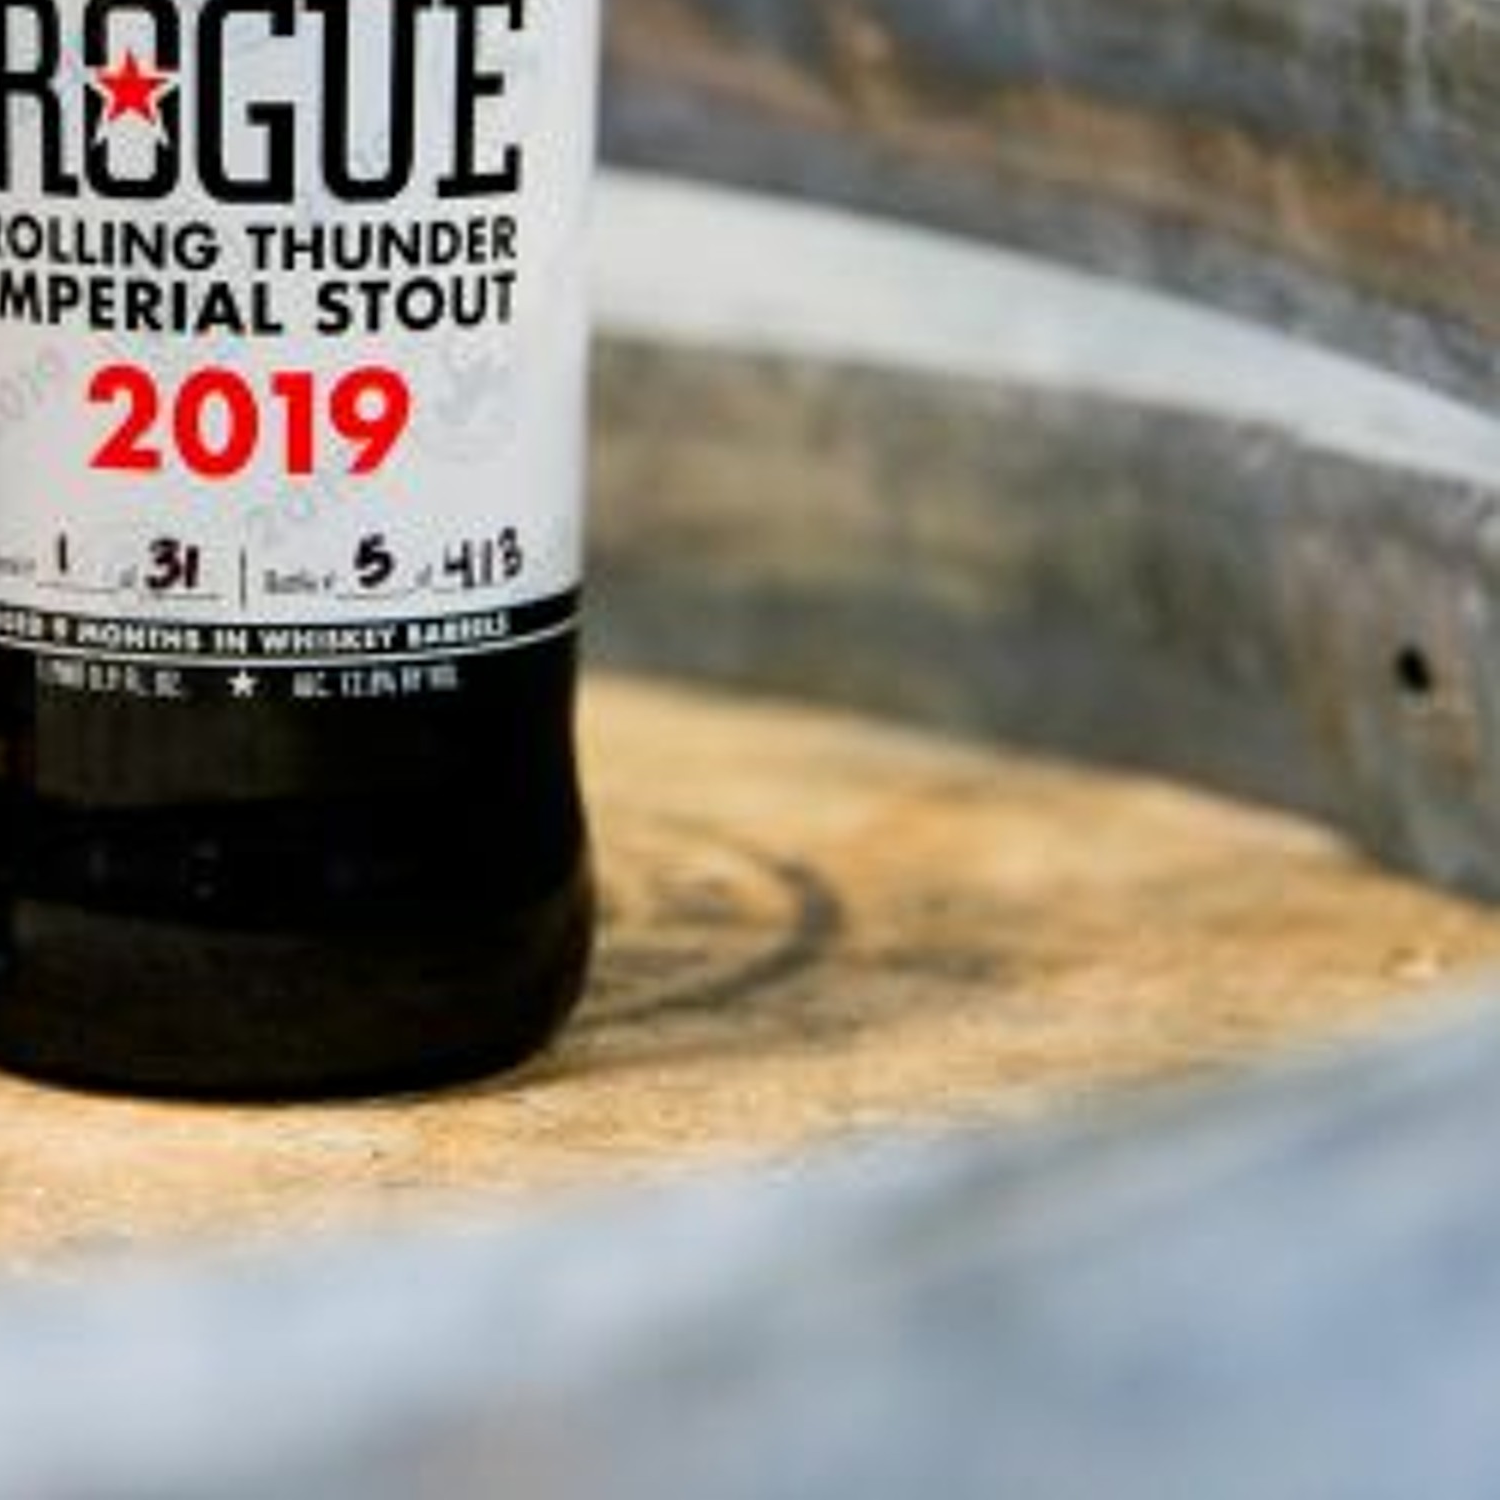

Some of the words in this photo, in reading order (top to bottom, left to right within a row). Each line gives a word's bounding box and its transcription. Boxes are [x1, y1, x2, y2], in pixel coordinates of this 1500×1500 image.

[245, 215, 519, 273] THUNDER
[315, 273, 518, 337] STOUT
[86, 363, 412, 482] 2019
[146, 537, 200, 590] 31
[355, 533, 395, 589] 5
[444, 527, 523, 591] 413
[77, 622, 199, 651] MONTHS
[213, 629, 248, 654] IN
[257, 624, 397, 653] WHISKEY
